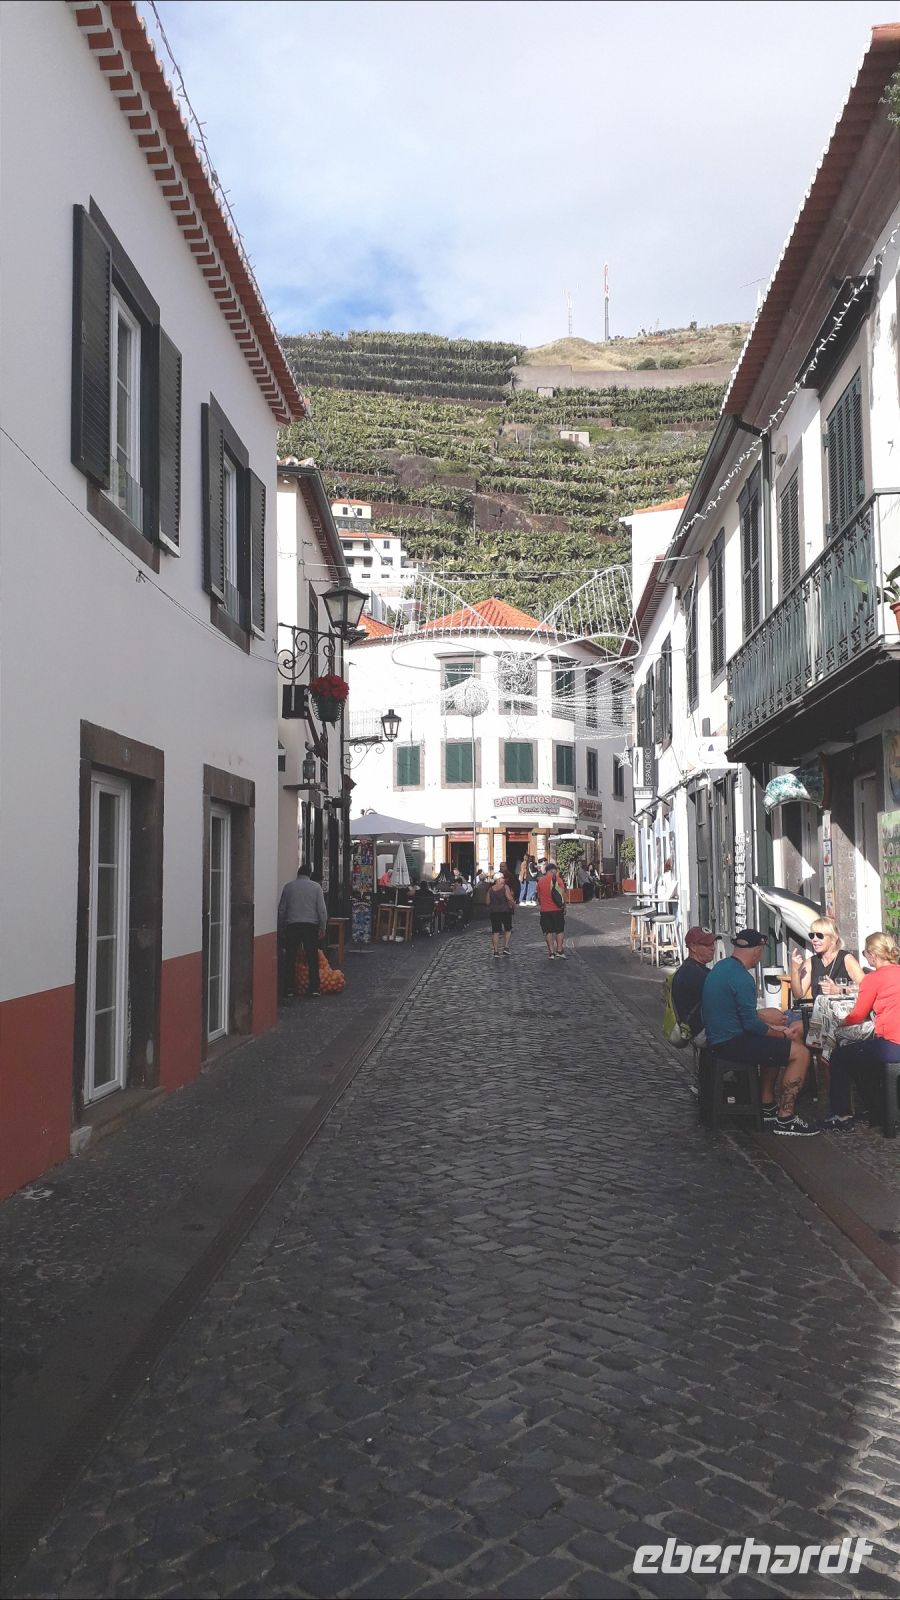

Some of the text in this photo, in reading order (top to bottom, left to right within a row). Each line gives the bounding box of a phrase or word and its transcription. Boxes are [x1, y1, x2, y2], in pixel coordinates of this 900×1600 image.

[644, 748, 652, 786] ESPADERO
[494, 797, 515, 807] BAR
[517, 795, 550, 804] FILHOS
